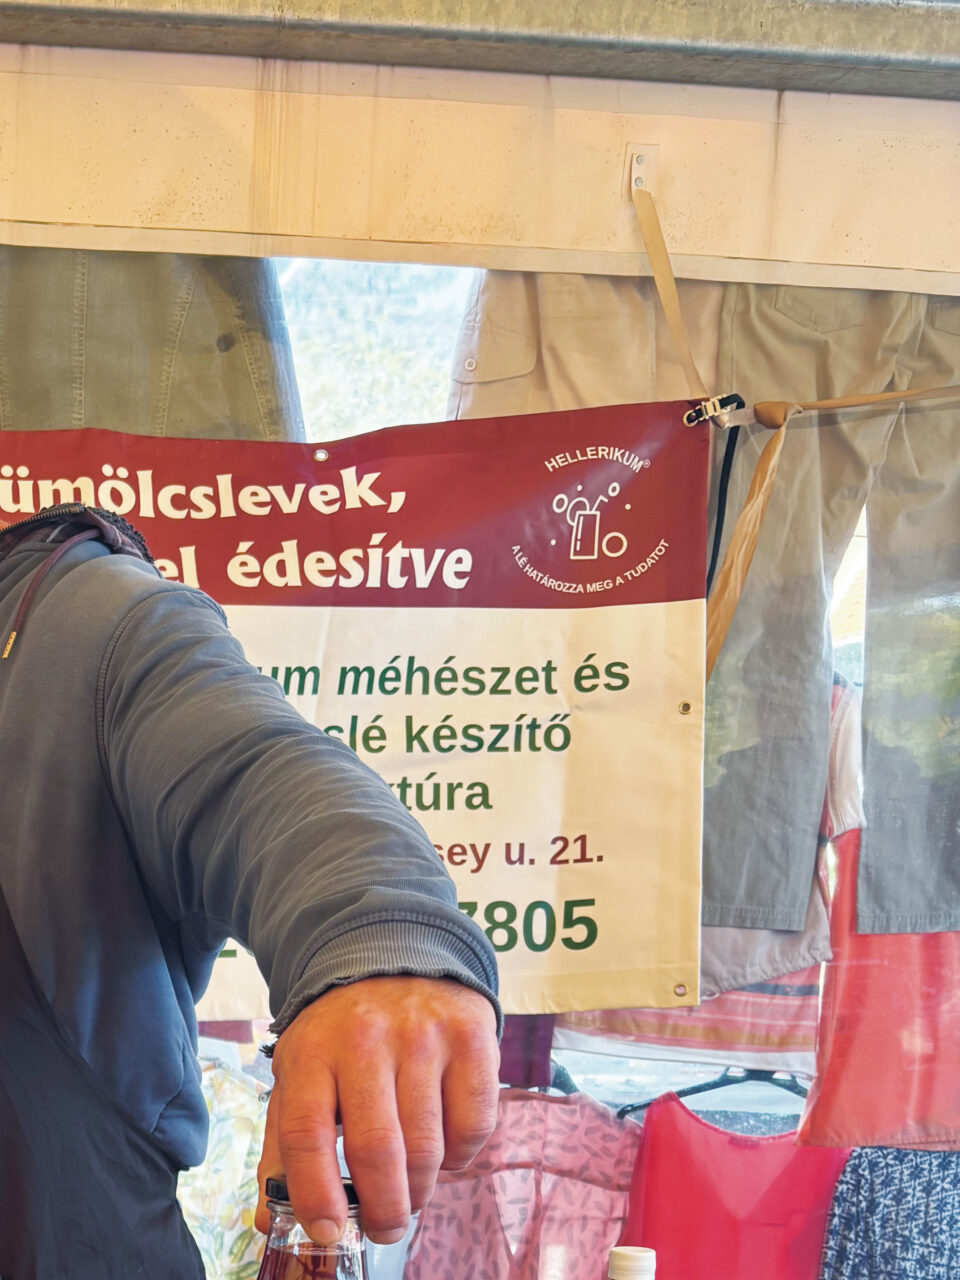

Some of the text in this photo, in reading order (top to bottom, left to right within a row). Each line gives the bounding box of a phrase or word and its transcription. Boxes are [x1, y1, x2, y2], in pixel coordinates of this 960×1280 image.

[227, 533, 473, 590] édesítve
[512, 538, 669, 594] A LÉ HATÁROZZA MEG A TUDATOT
[337, 655, 558, 696] méhészet
[573, 653, 630, 693] és
[405, 713, 571, 754] készítő
[504, 842, 536, 866] u.
[549, 833, 604, 866] 21.
